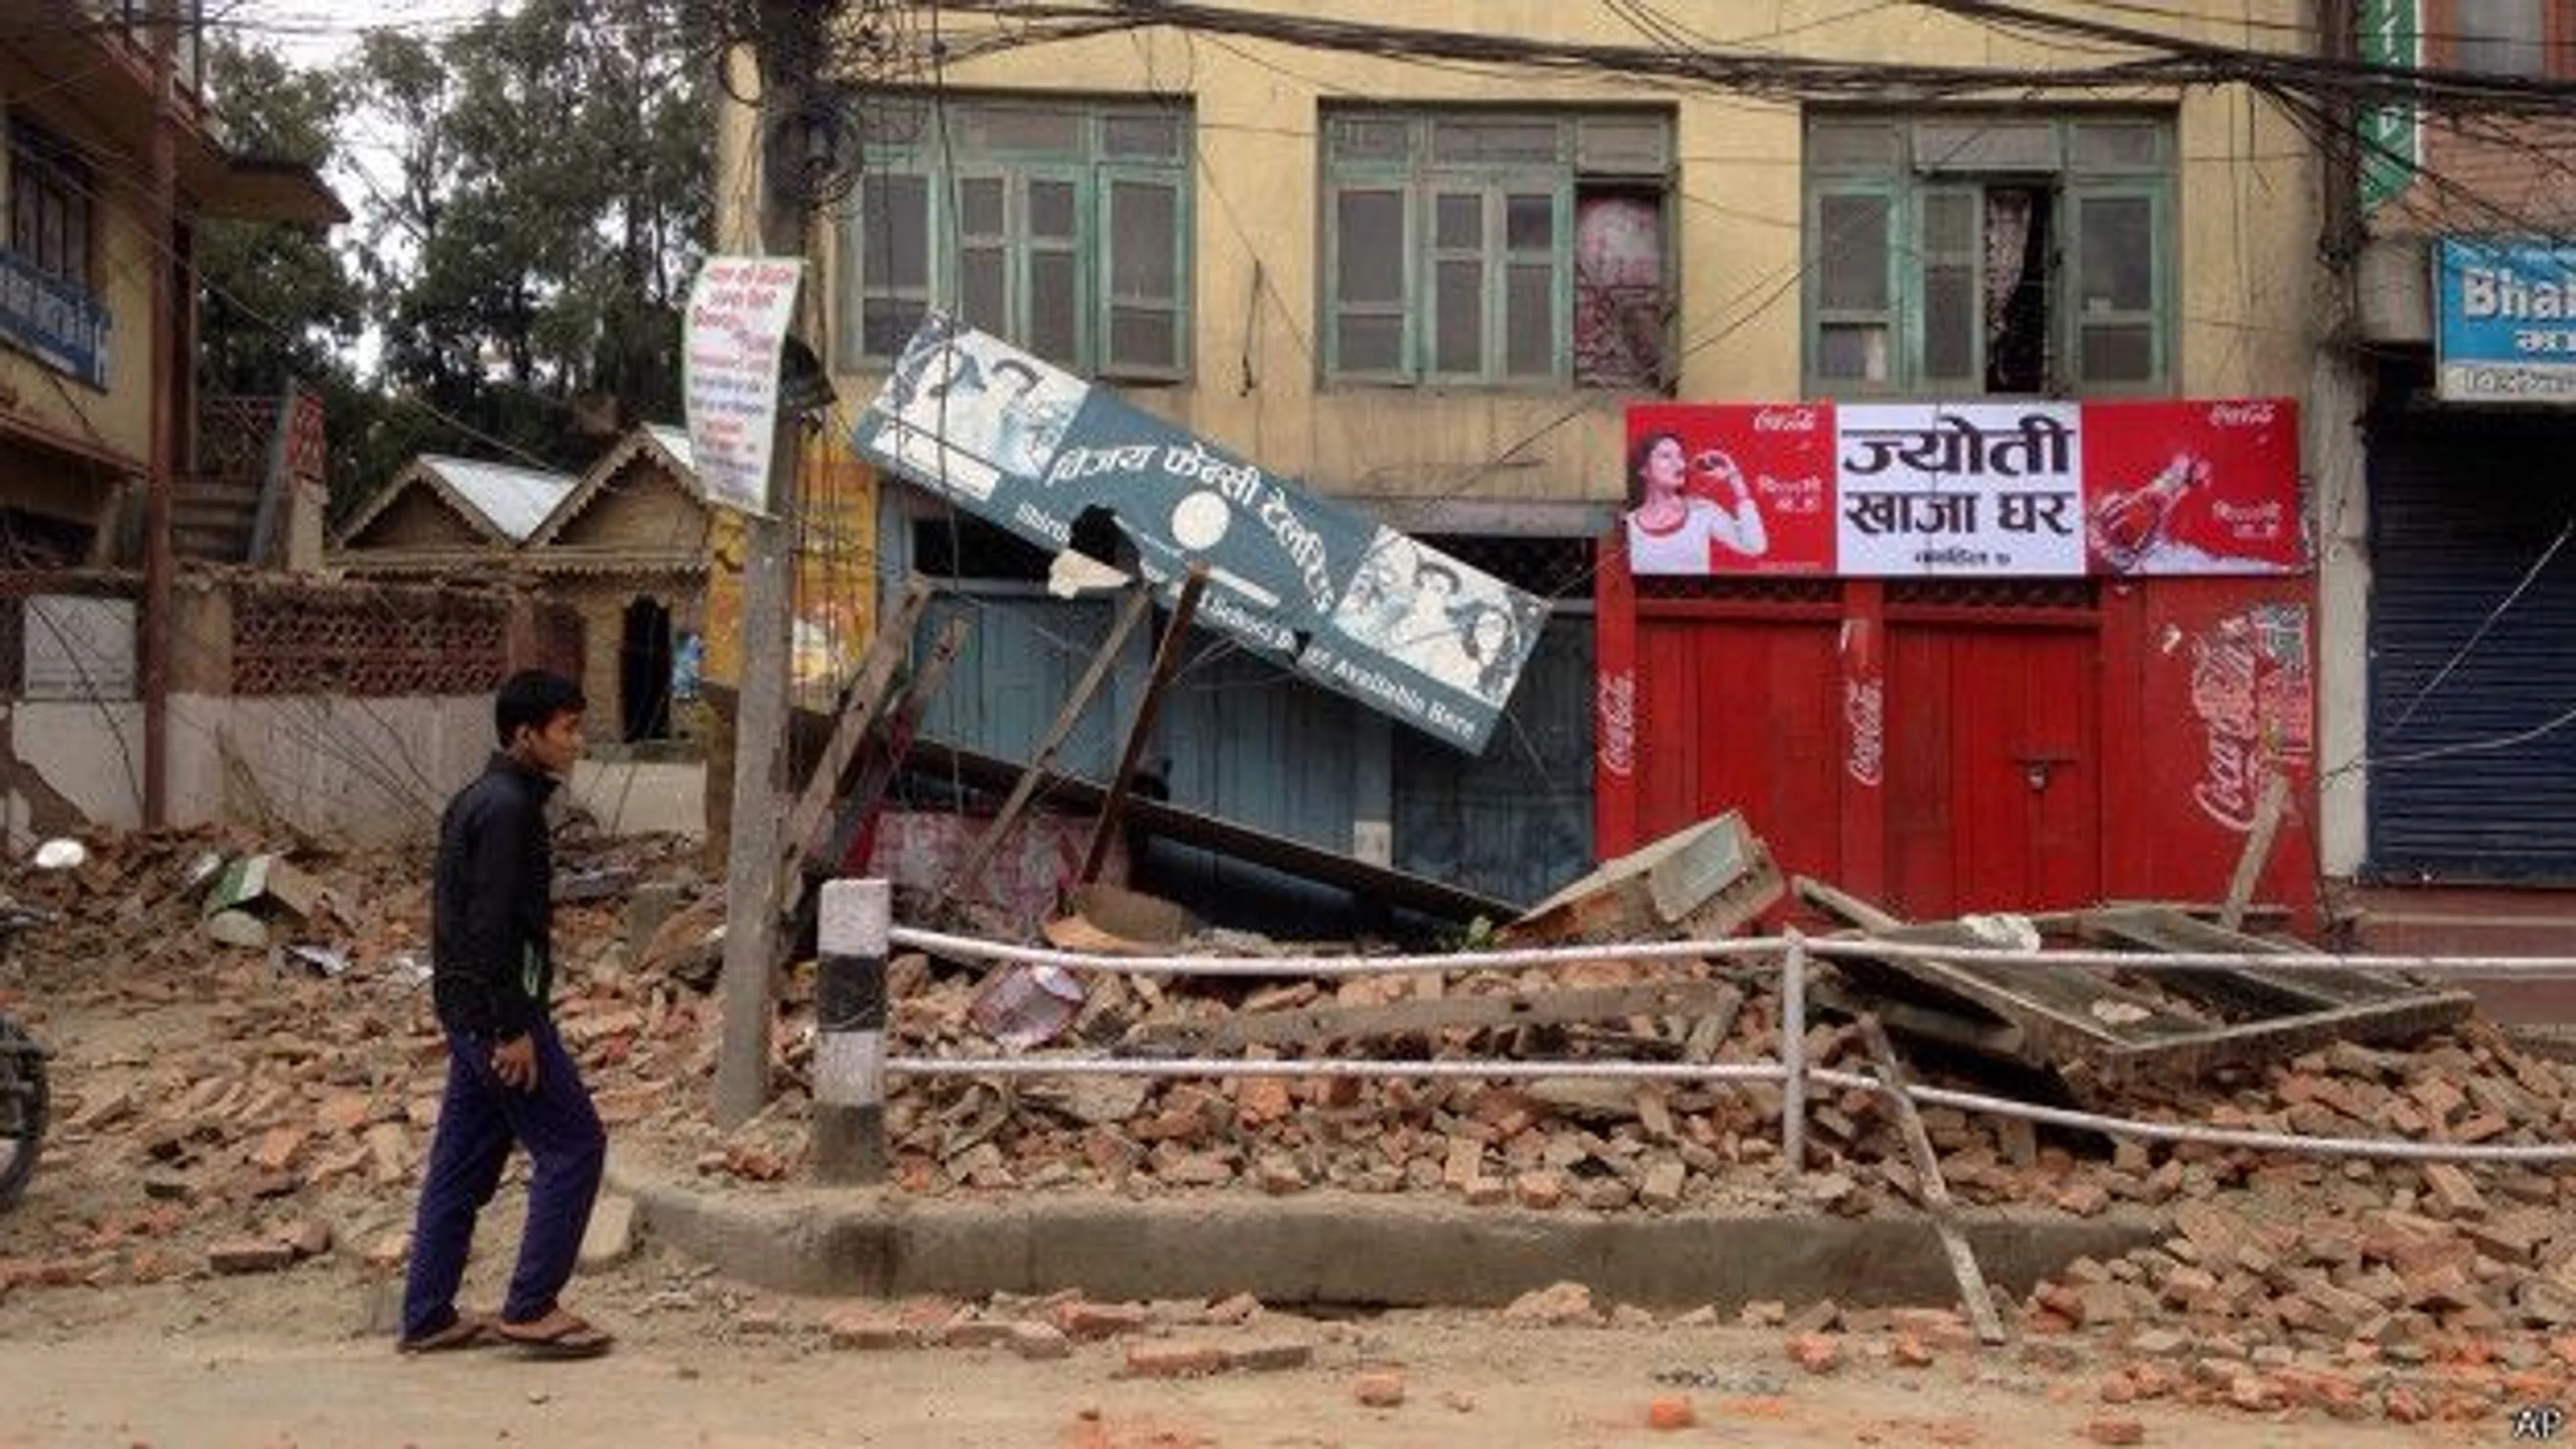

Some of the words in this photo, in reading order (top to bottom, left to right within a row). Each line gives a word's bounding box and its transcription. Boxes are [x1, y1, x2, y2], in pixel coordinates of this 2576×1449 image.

[1841, 413, 2077, 477] ज्योती
[1844, 491, 1982, 535] खाजा
[1996, 491, 2077, 537] घर
